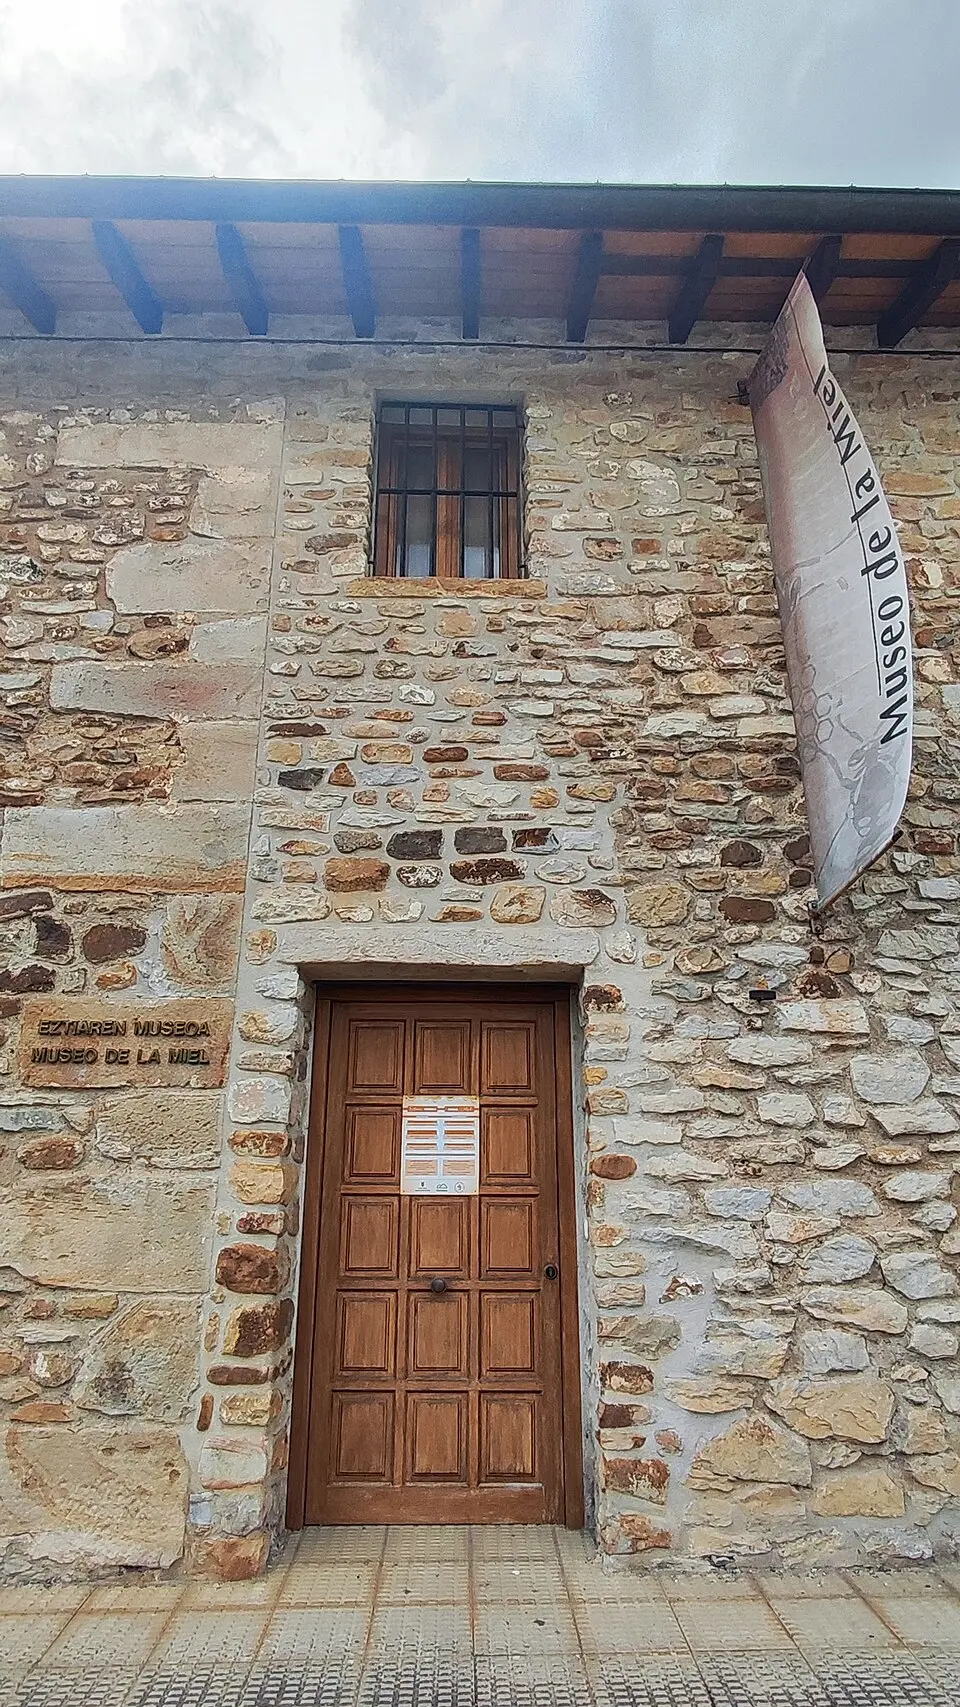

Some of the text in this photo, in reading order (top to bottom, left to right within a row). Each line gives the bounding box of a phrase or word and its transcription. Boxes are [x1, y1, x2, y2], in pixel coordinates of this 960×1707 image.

[813, 364, 908, 745] Museo de la Miel
[37, 1019, 211, 1038] EZTIAREN MUSEOA
[31, 1047, 211, 1065] MUSEO DE LA MIEL
